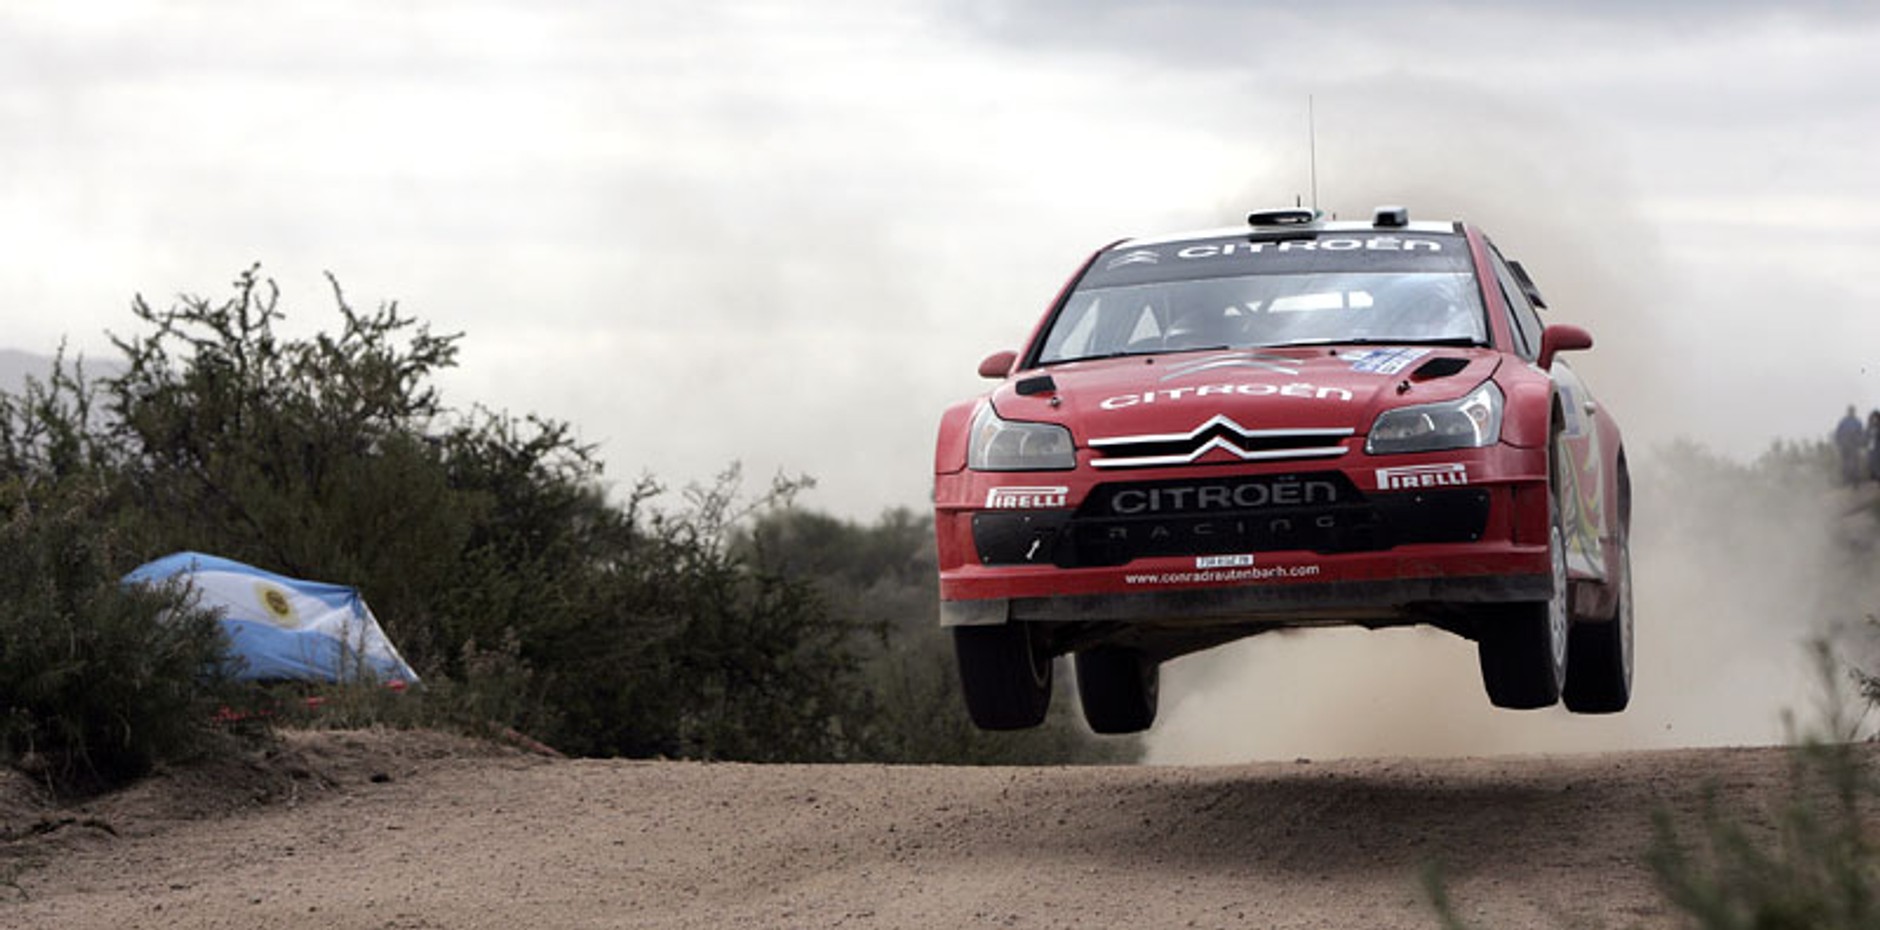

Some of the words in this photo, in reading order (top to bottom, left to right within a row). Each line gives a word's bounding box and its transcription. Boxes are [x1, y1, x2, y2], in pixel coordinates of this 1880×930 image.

[1100, 382, 1353, 409] CITROËN
[1376, 463, 1467, 489] PIRELLI
[985, 486, 1068, 508] PIRELLI
[1112, 476, 1336, 513] CITROËN
[1109, 516, 1335, 538] RACING
[1126, 565, 1319, 583] www.conradrautenbach.com
